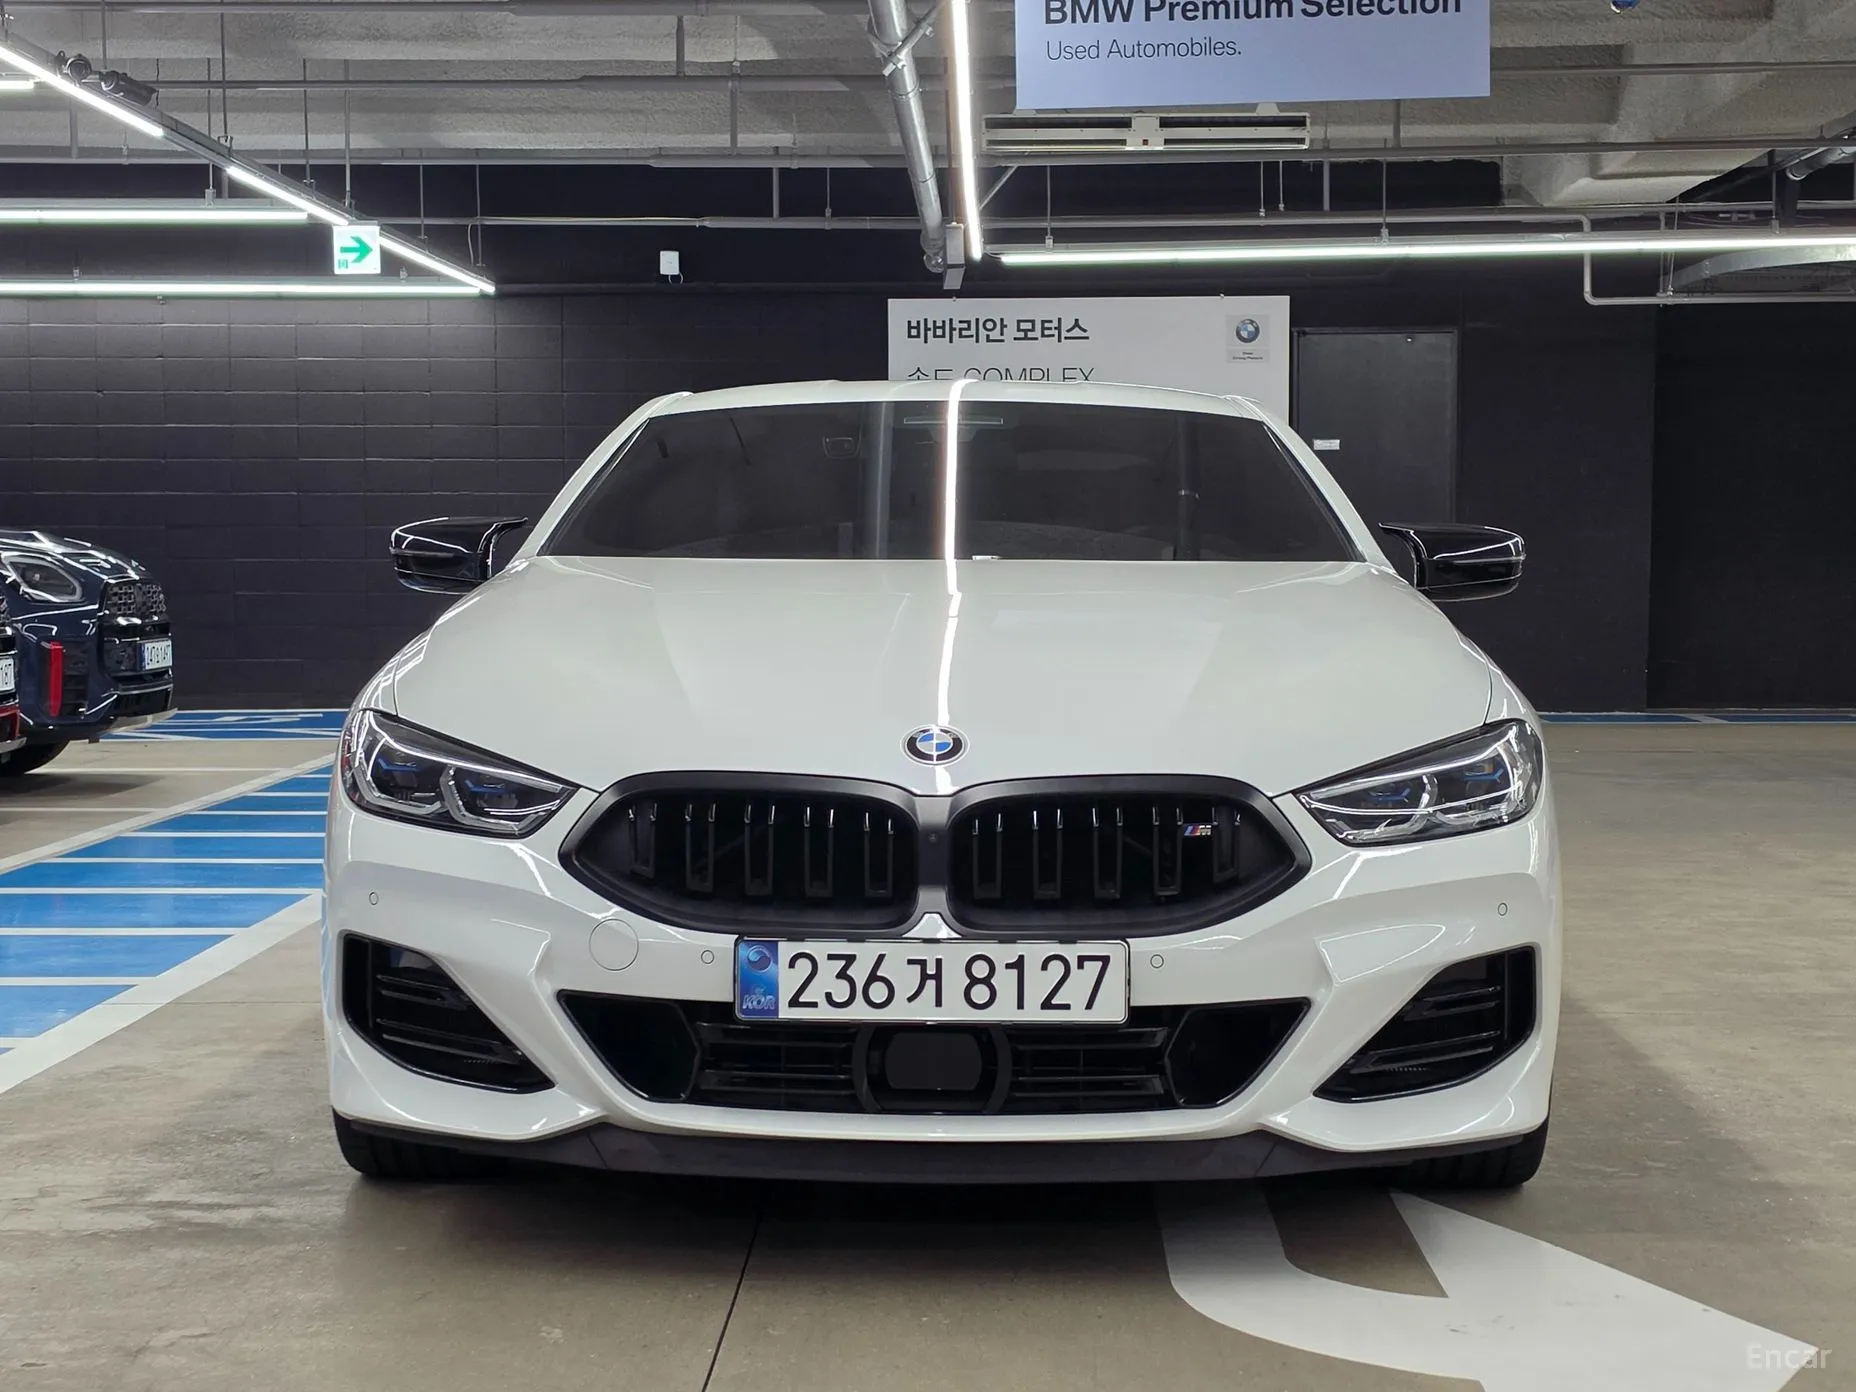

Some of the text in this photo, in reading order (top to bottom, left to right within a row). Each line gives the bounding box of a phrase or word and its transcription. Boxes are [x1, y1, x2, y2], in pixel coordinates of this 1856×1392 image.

[1045, 0, 1135, 24] BMW
[1144, 0, 1294, 21] Premium
[1046, 37, 1242, 60] Used Automobiles.
[907, 317, 1090, 344] 바바리안 모터스
[787, 951, 1111, 1011] 236거 8127
[742, 993, 776, 1010] KOR
